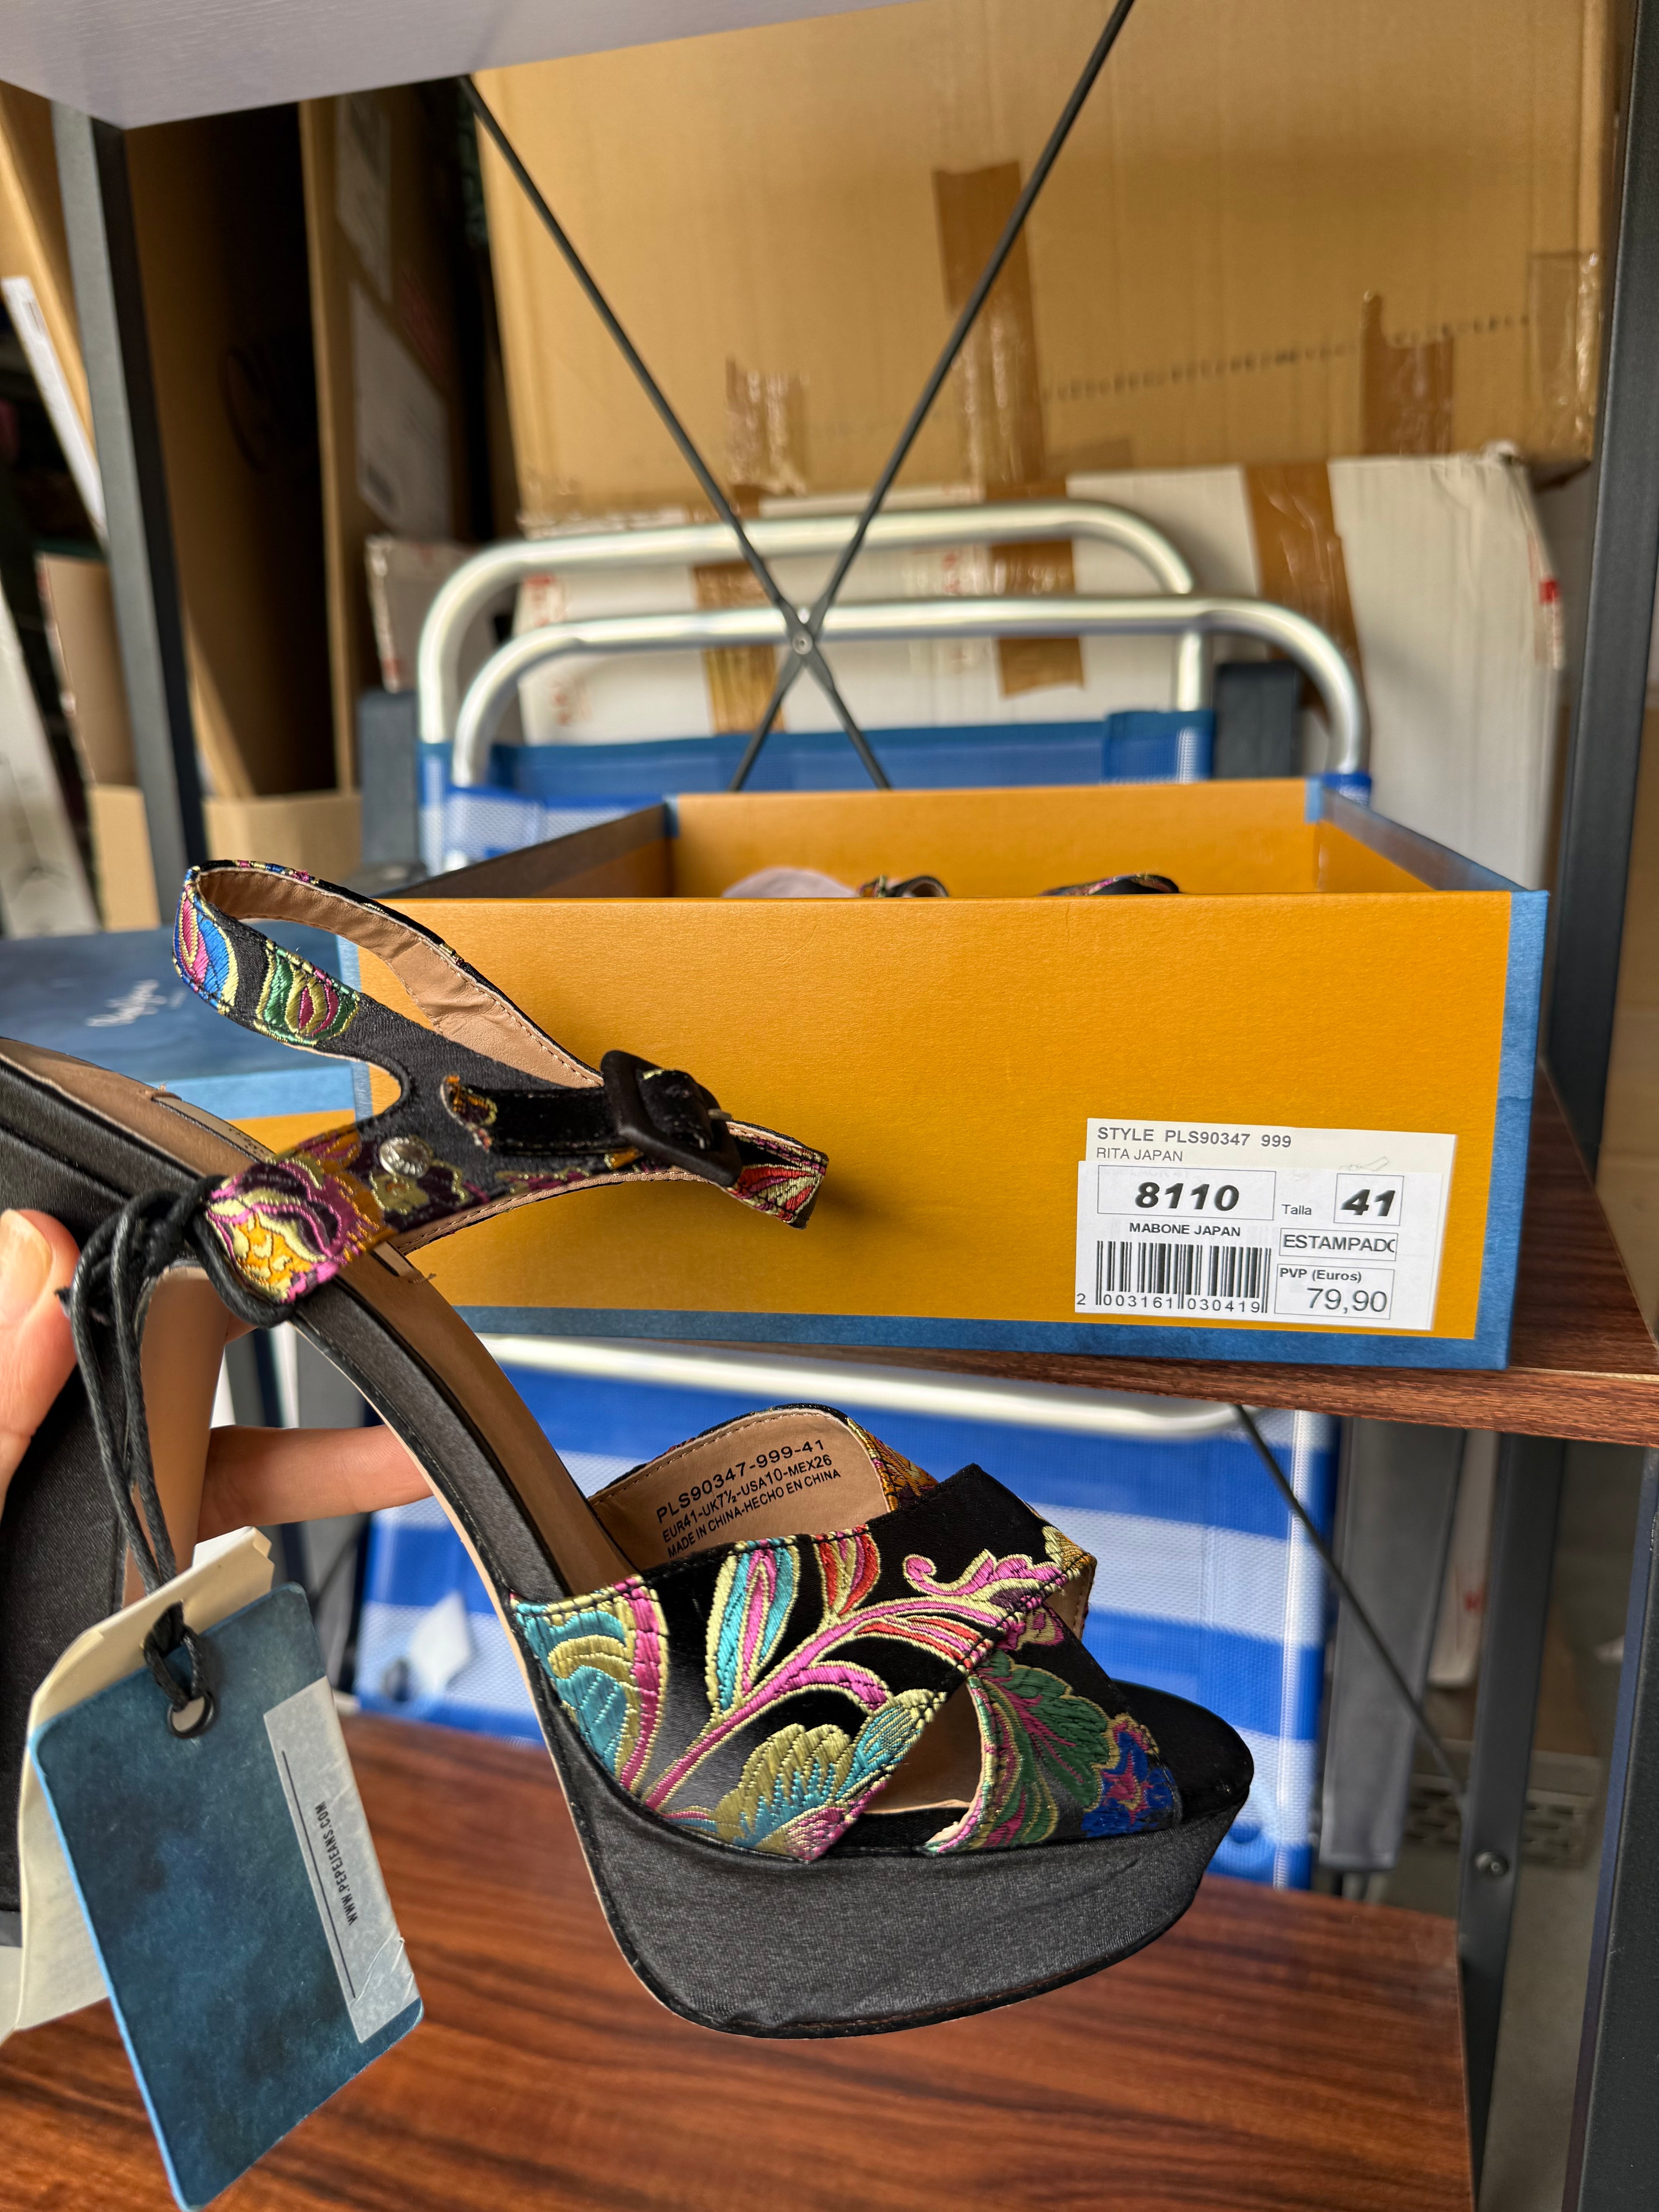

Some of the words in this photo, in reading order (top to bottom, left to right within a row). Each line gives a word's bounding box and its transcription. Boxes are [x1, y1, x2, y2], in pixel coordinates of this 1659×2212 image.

[1097, 1127, 1154, 1141] STYLE
[1165, 1130, 1250, 1146] PLS90347
[1260, 1135, 1291, 1147] 999
[1096, 1147, 1130, 1160] RITA
[1134, 1149, 1182, 1162] JAPAN
[1135, 1182, 1240, 1211] 8110
[1340, 1189, 1396, 1217] 41
[1281, 1204, 1312, 1215] Talla
[1128, 1222, 1190, 1235] MABONE
[1193, 1224, 1241, 1237] JAPAN
[1279, 1268, 1307, 1278] PVP
[1312, 1269, 1362, 1284] (Euros)
[1077, 1293, 1086, 1305] 2
[1103, 1294, 1173, 1309] 003161
[1188, 1298, 1260, 1313] 030419
[1306, 1287, 1387, 1314] 79,90
[657, 1440, 824, 1524] PLS90347-999-41
[667, 1534, 696, 1558] MADE
[696, 1526, 707, 1540] IN
[708, 1487, 784, 1532] CHINA-HECHO
[786, 1478, 803, 1494] EN
[804, 1469, 841, 1487] CHINA
[315, 1801, 359, 1926] WWW.PEPEJEANS.COM
